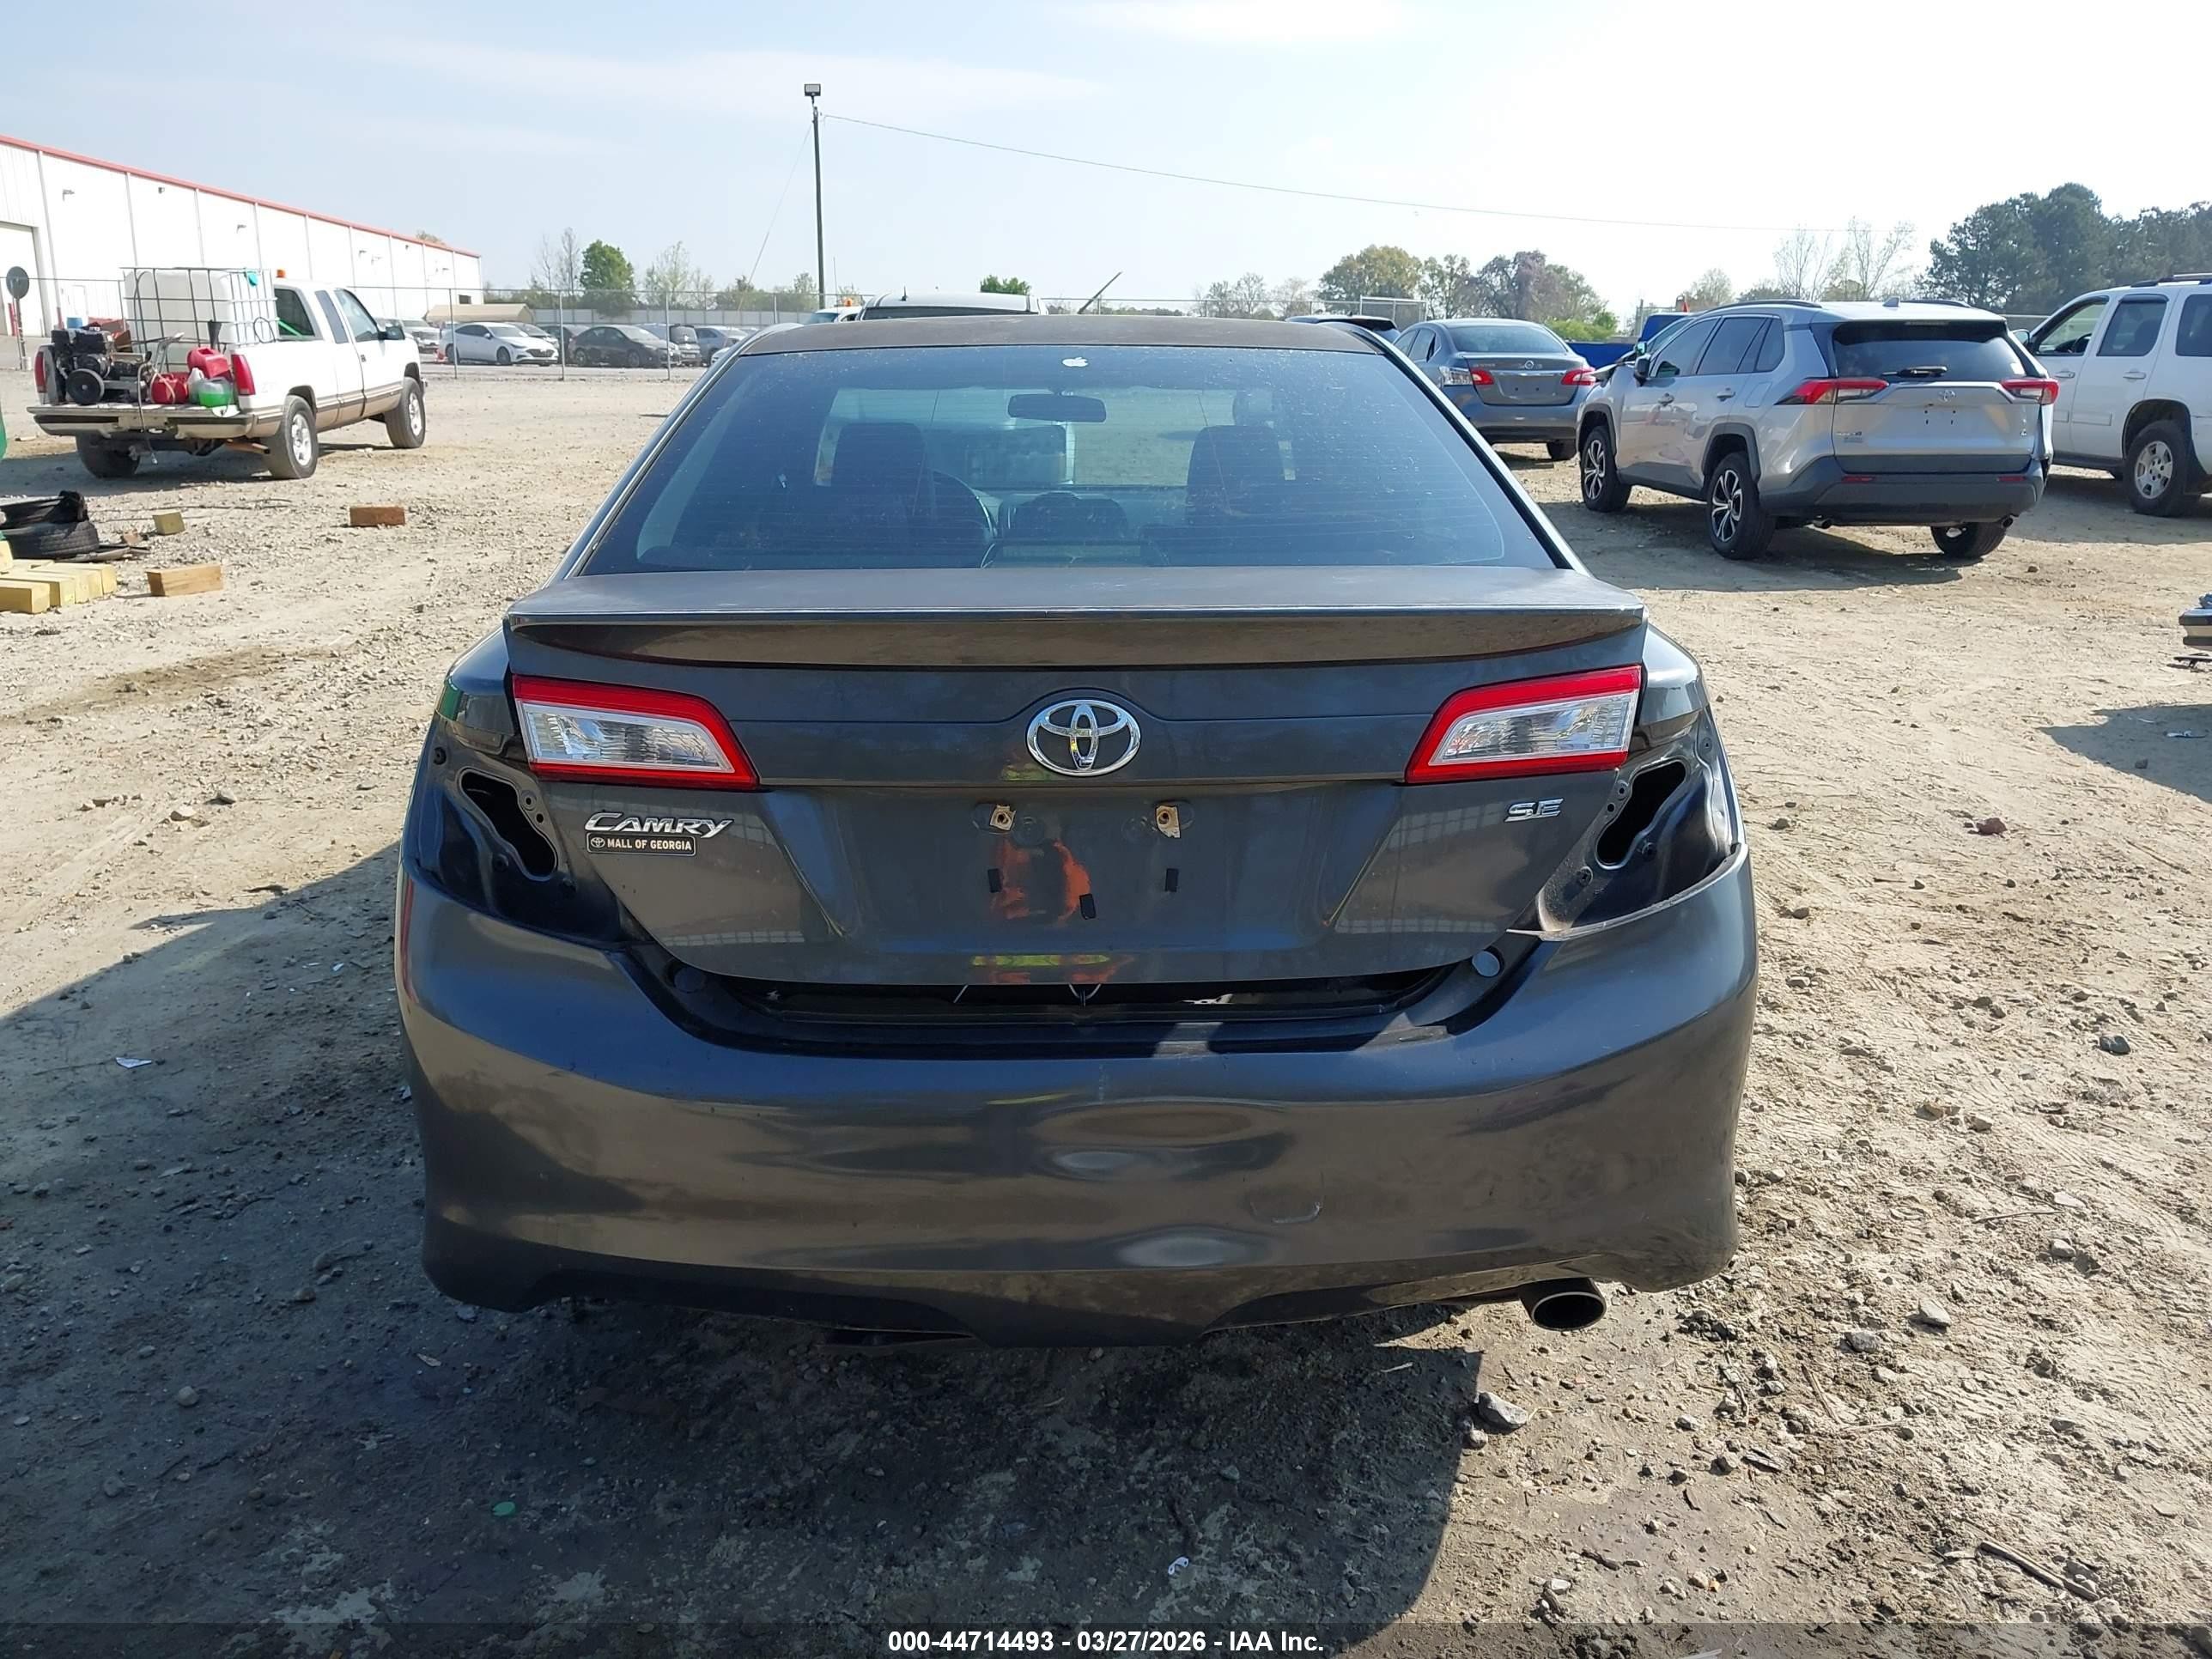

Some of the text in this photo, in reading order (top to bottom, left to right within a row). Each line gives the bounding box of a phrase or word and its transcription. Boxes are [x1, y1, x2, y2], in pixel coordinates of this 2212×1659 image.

[1504, 798, 1564, 822] SE
[585, 811, 732, 838] CAMRY
[607, 838, 692, 851] MALL OF GEORGIA
